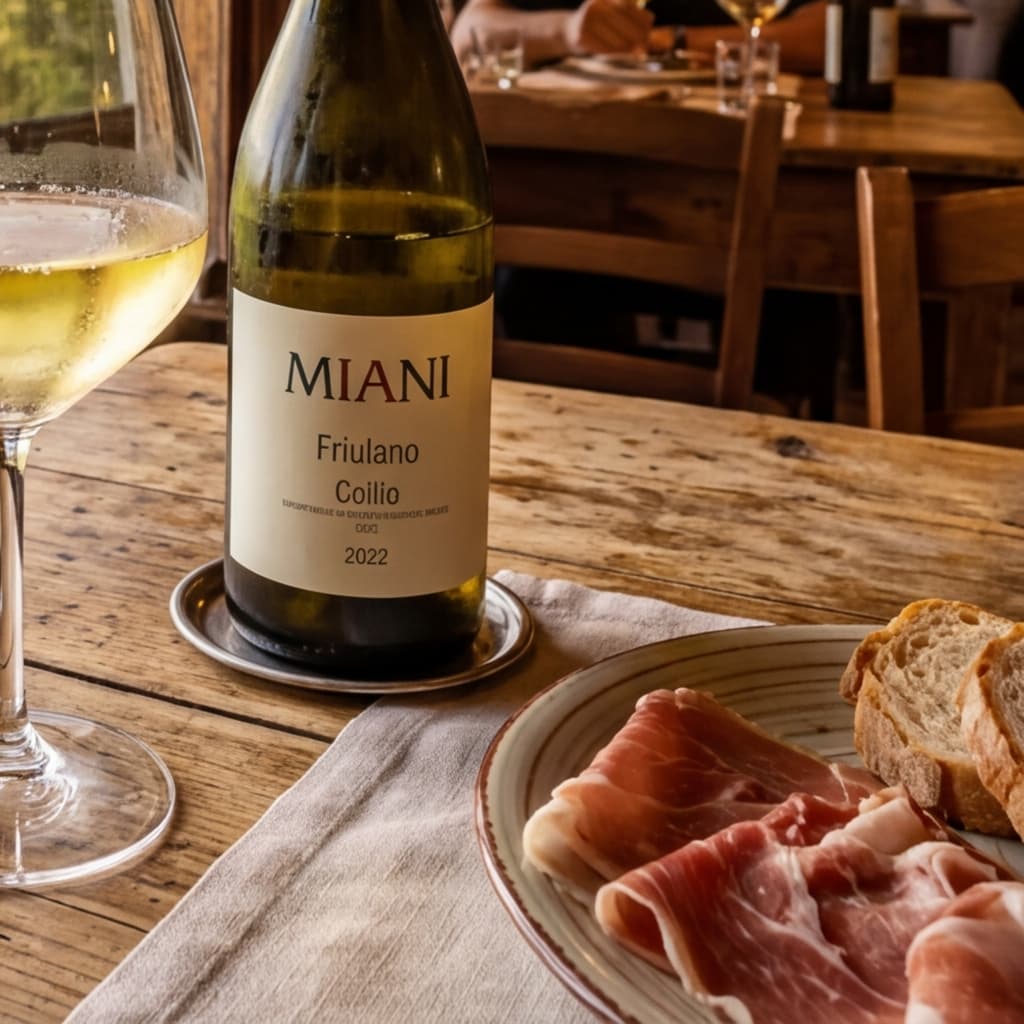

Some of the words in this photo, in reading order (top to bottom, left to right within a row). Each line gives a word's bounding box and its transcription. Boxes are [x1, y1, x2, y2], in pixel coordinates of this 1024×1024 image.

[285, 351, 450, 403] MIANI
[317, 434, 419, 465] Friulano
[344, 547, 388, 566] 2022
